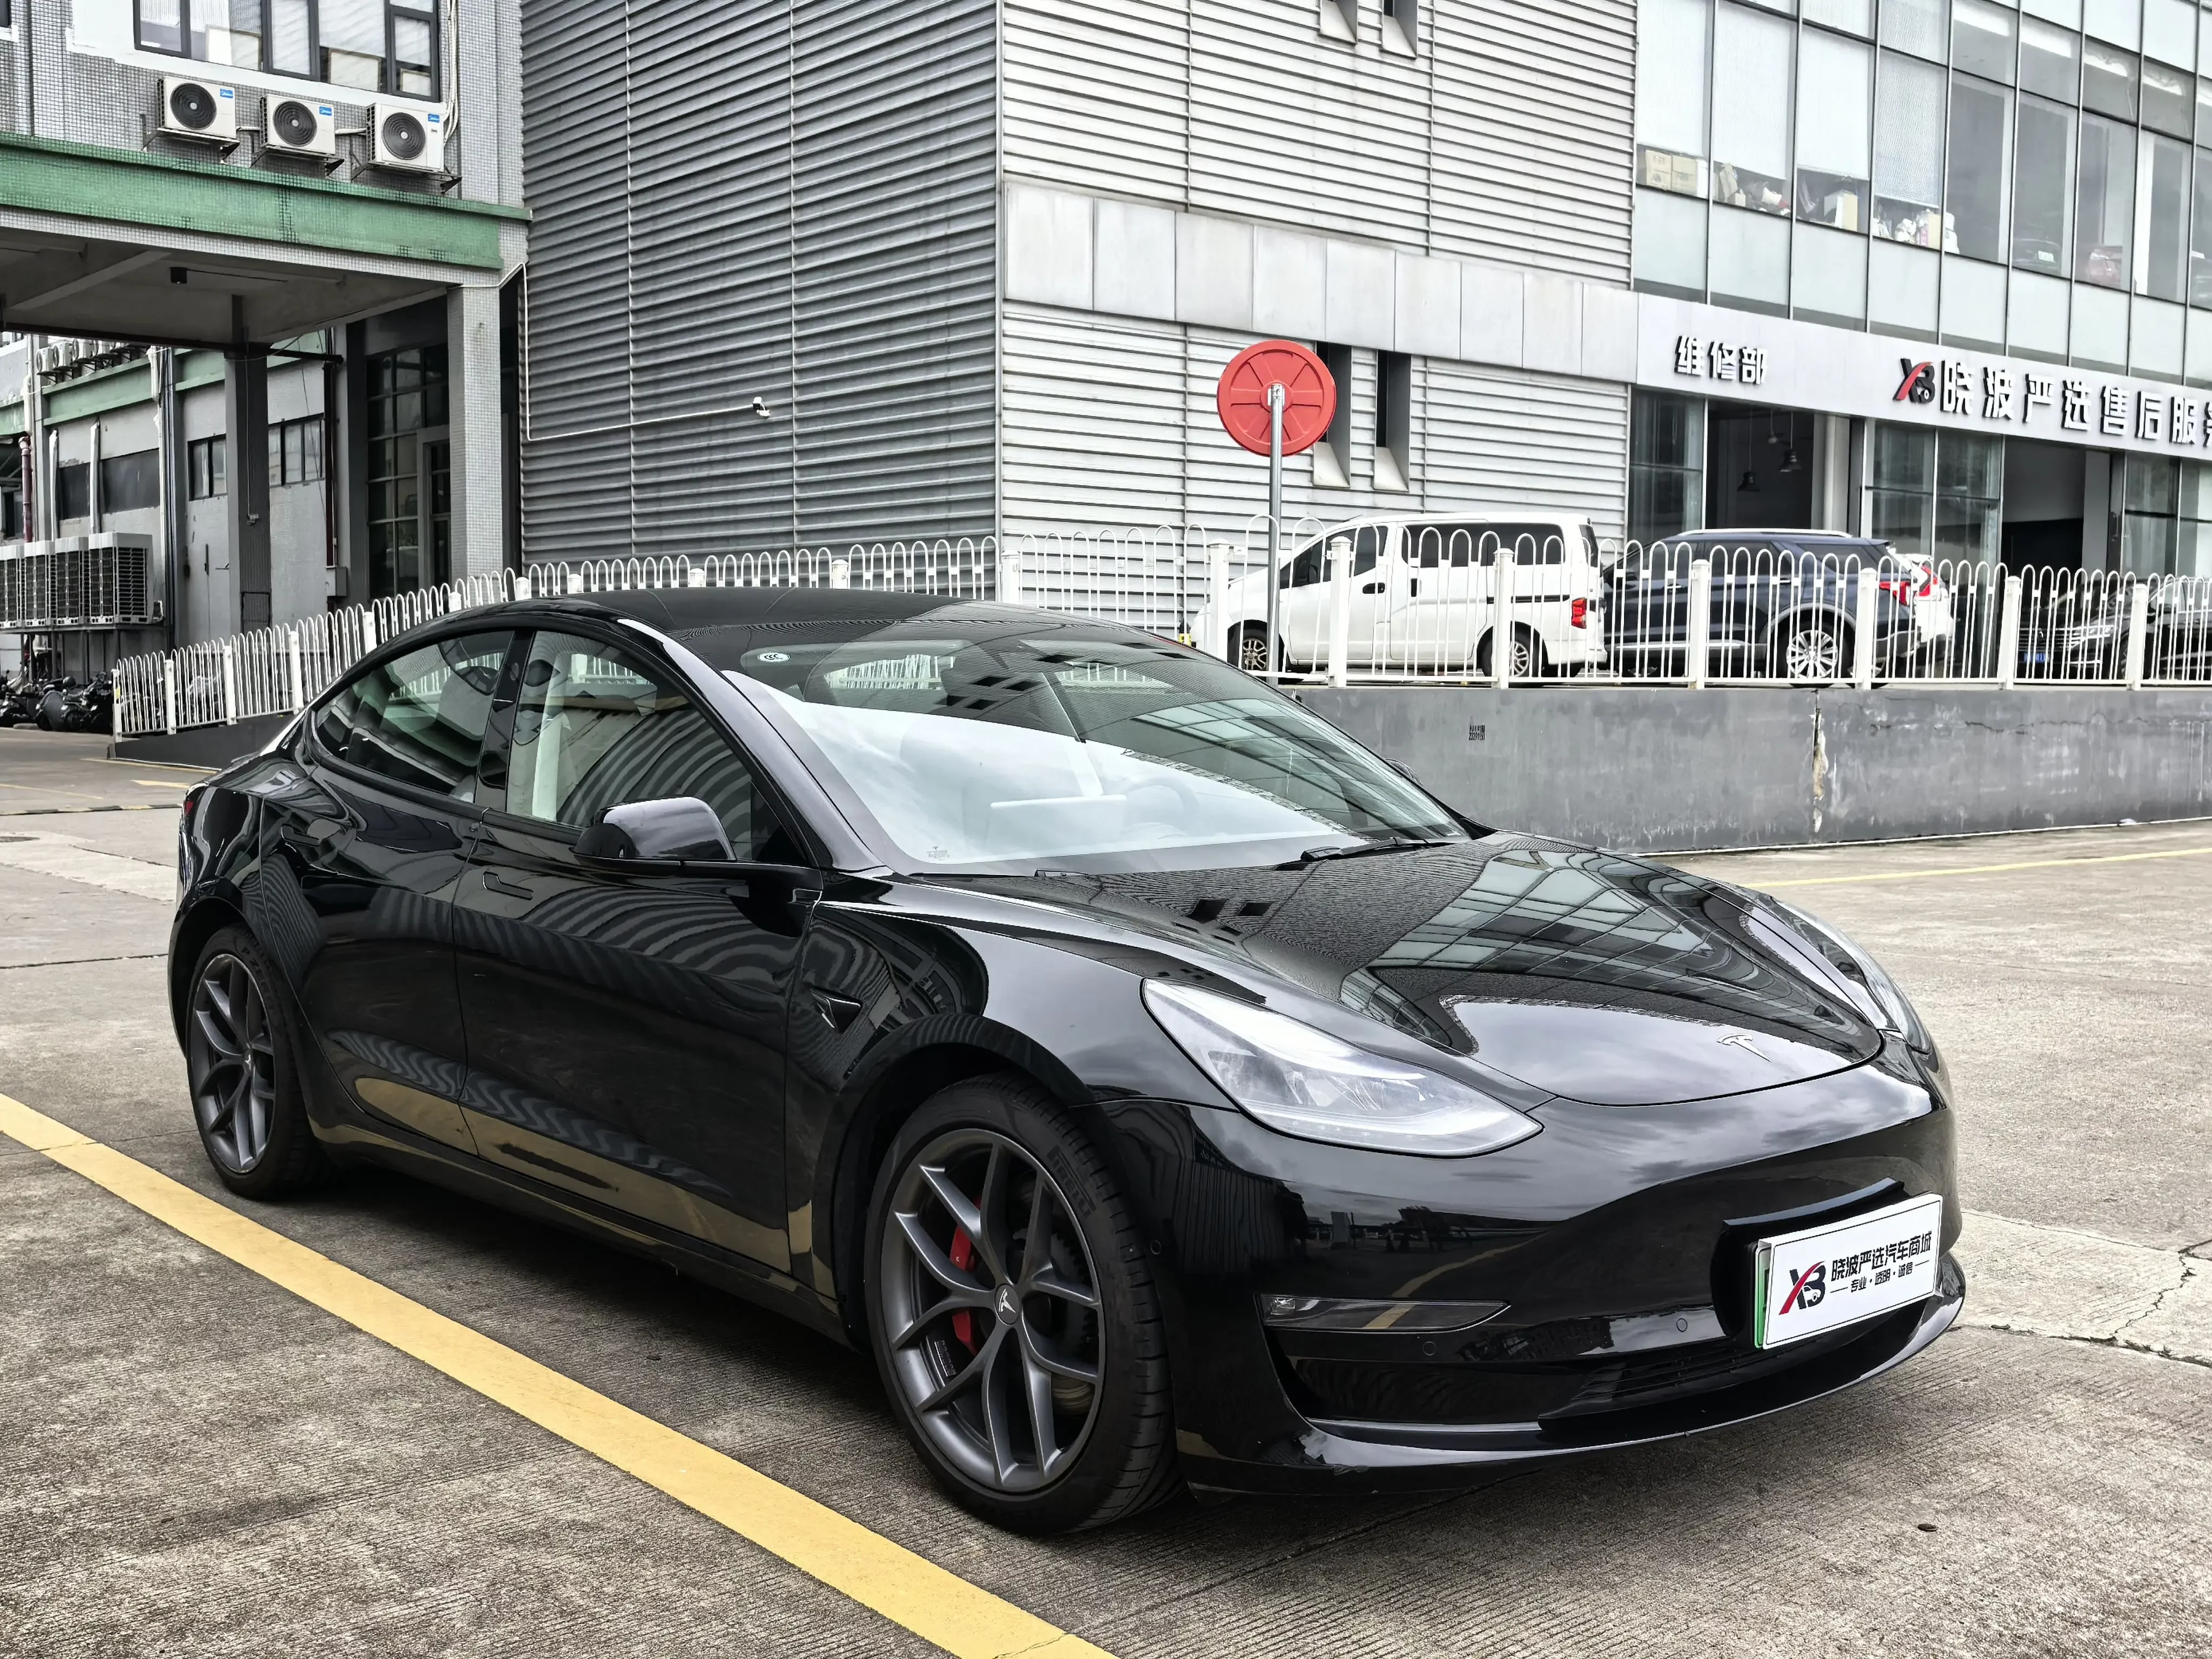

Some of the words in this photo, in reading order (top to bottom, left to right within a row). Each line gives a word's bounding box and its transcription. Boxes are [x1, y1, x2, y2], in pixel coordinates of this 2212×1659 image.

[1675, 335, 1768, 385] 维修部
[1940, 360, 2212, 447] 晓波严选售后服
[1831, 1230, 1932, 1282] 晓波严选汽车商城
